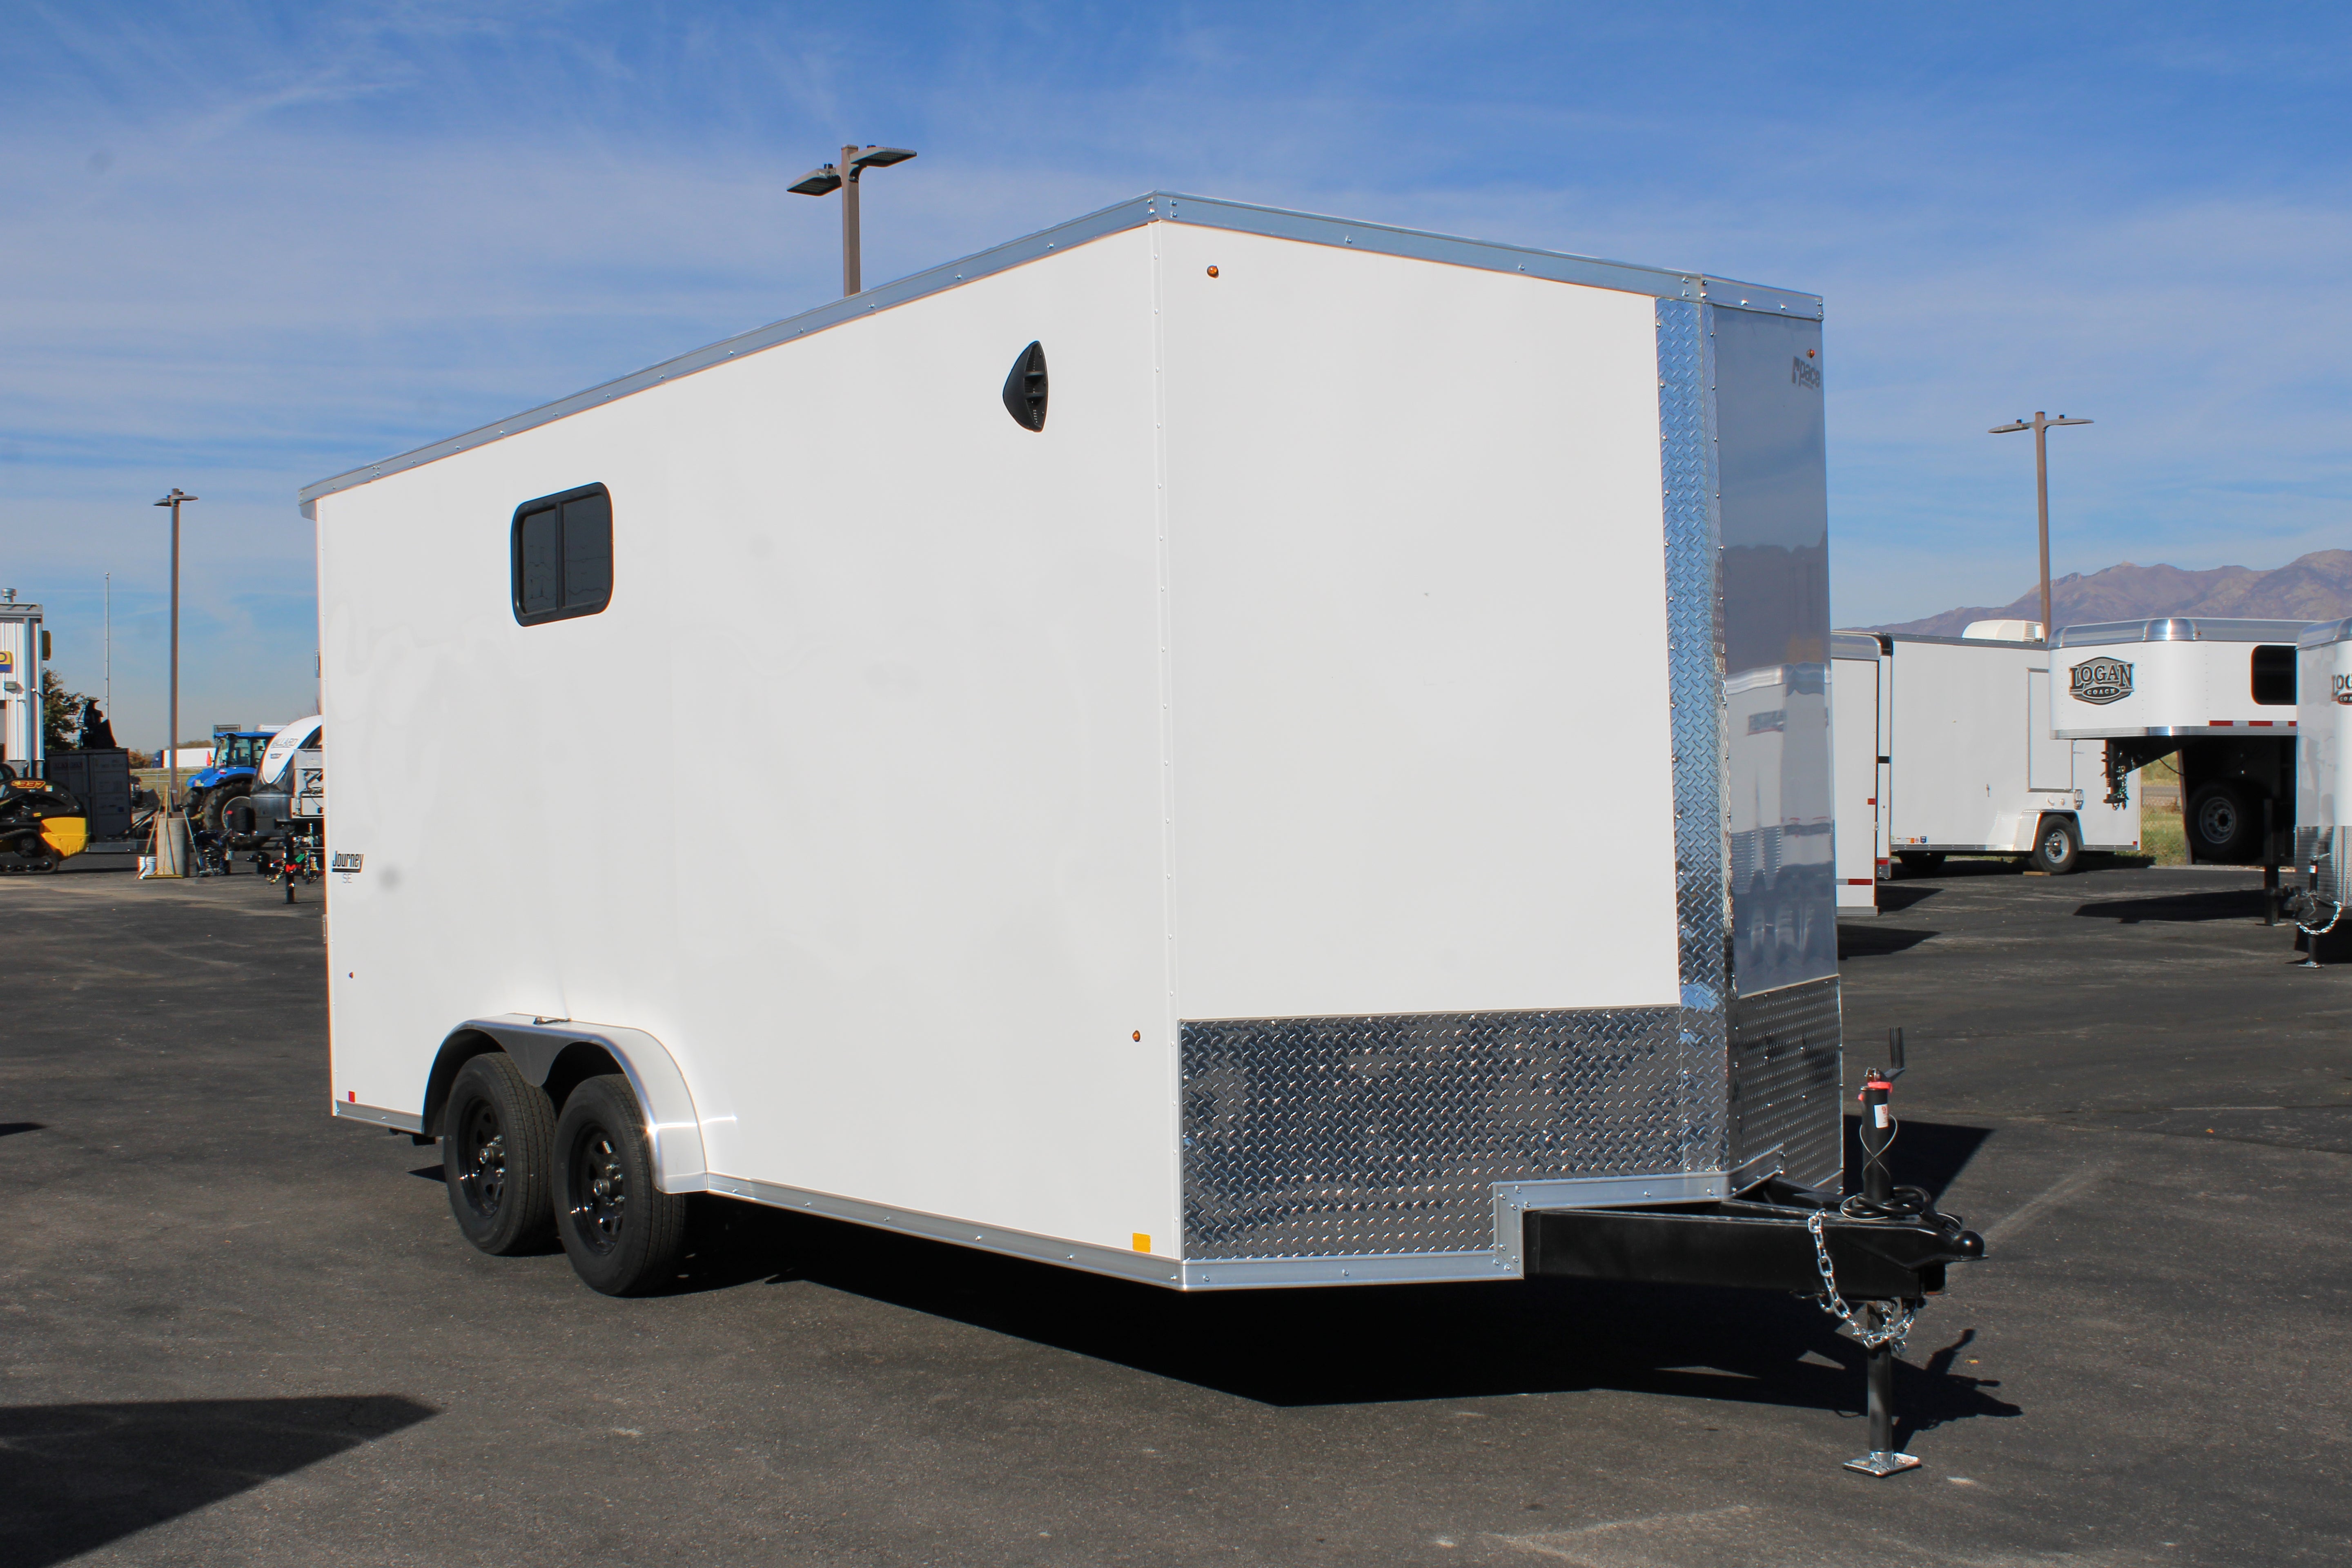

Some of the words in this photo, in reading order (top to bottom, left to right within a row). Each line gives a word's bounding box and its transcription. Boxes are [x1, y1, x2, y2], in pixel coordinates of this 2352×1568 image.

[1798, 360, 1820, 388] pace
[2069, 662, 2134, 690] LOGAN
[11, 780, 45, 788] C337
[332, 850, 365, 872] Journey
[343, 873, 352, 884] SE
